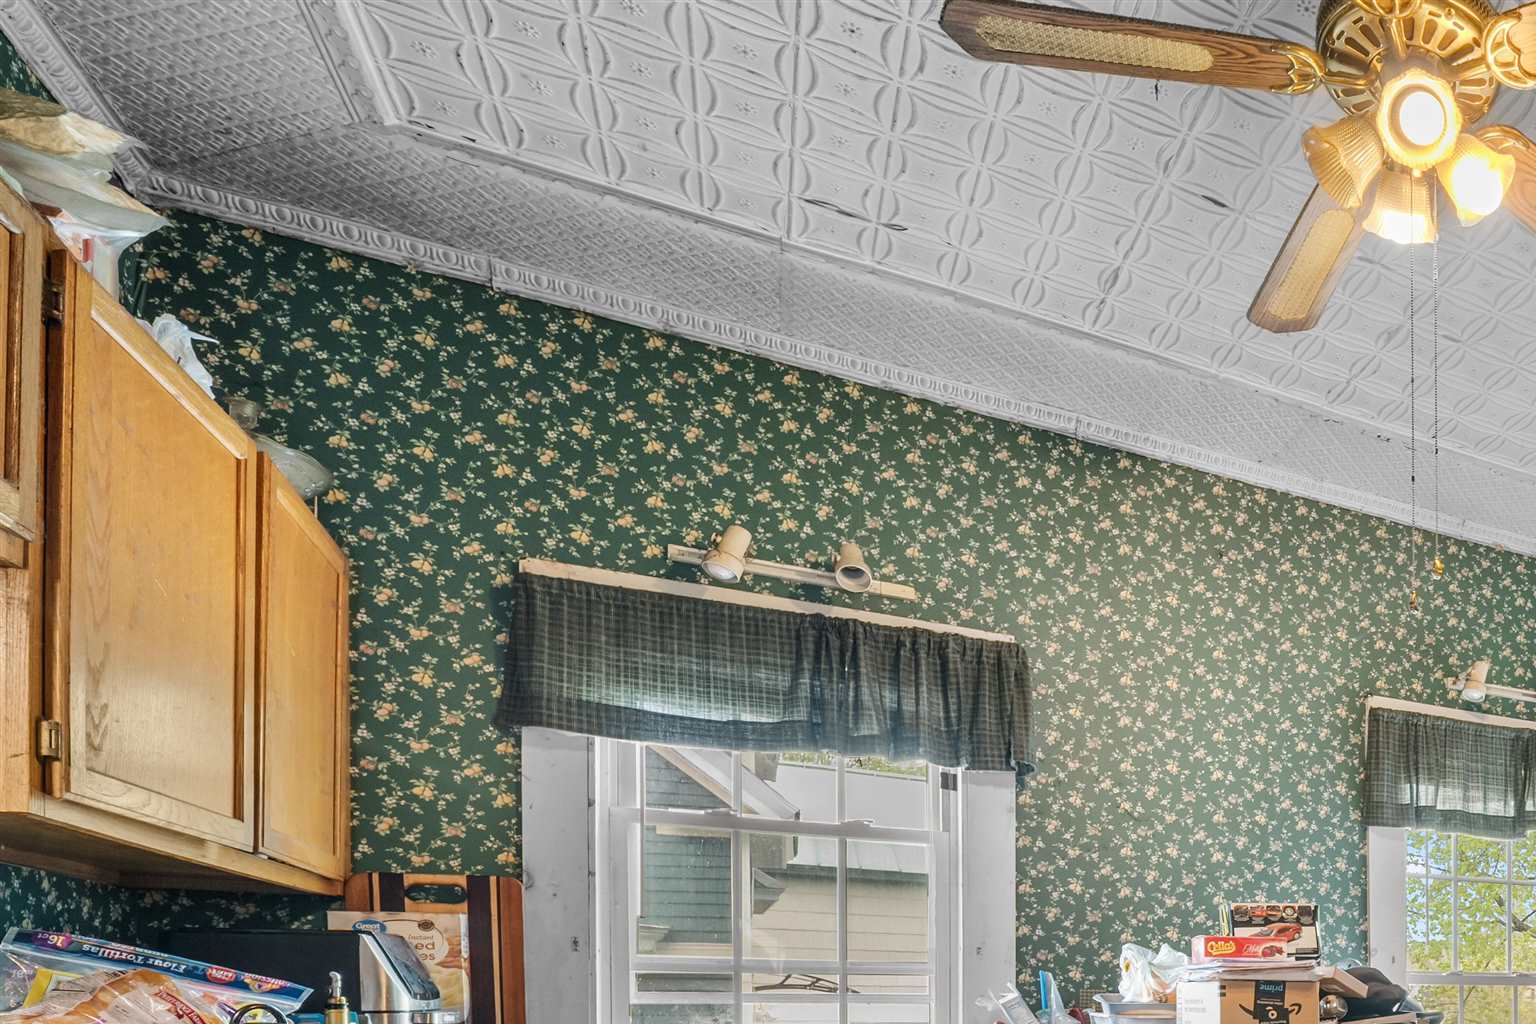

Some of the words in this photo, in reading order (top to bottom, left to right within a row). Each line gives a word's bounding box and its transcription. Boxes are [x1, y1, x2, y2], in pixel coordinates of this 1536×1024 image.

[82, 943, 146, 964] Tortillas
[145, 957, 187, 973] Flour
[1258, 983, 1284, 993] prime
